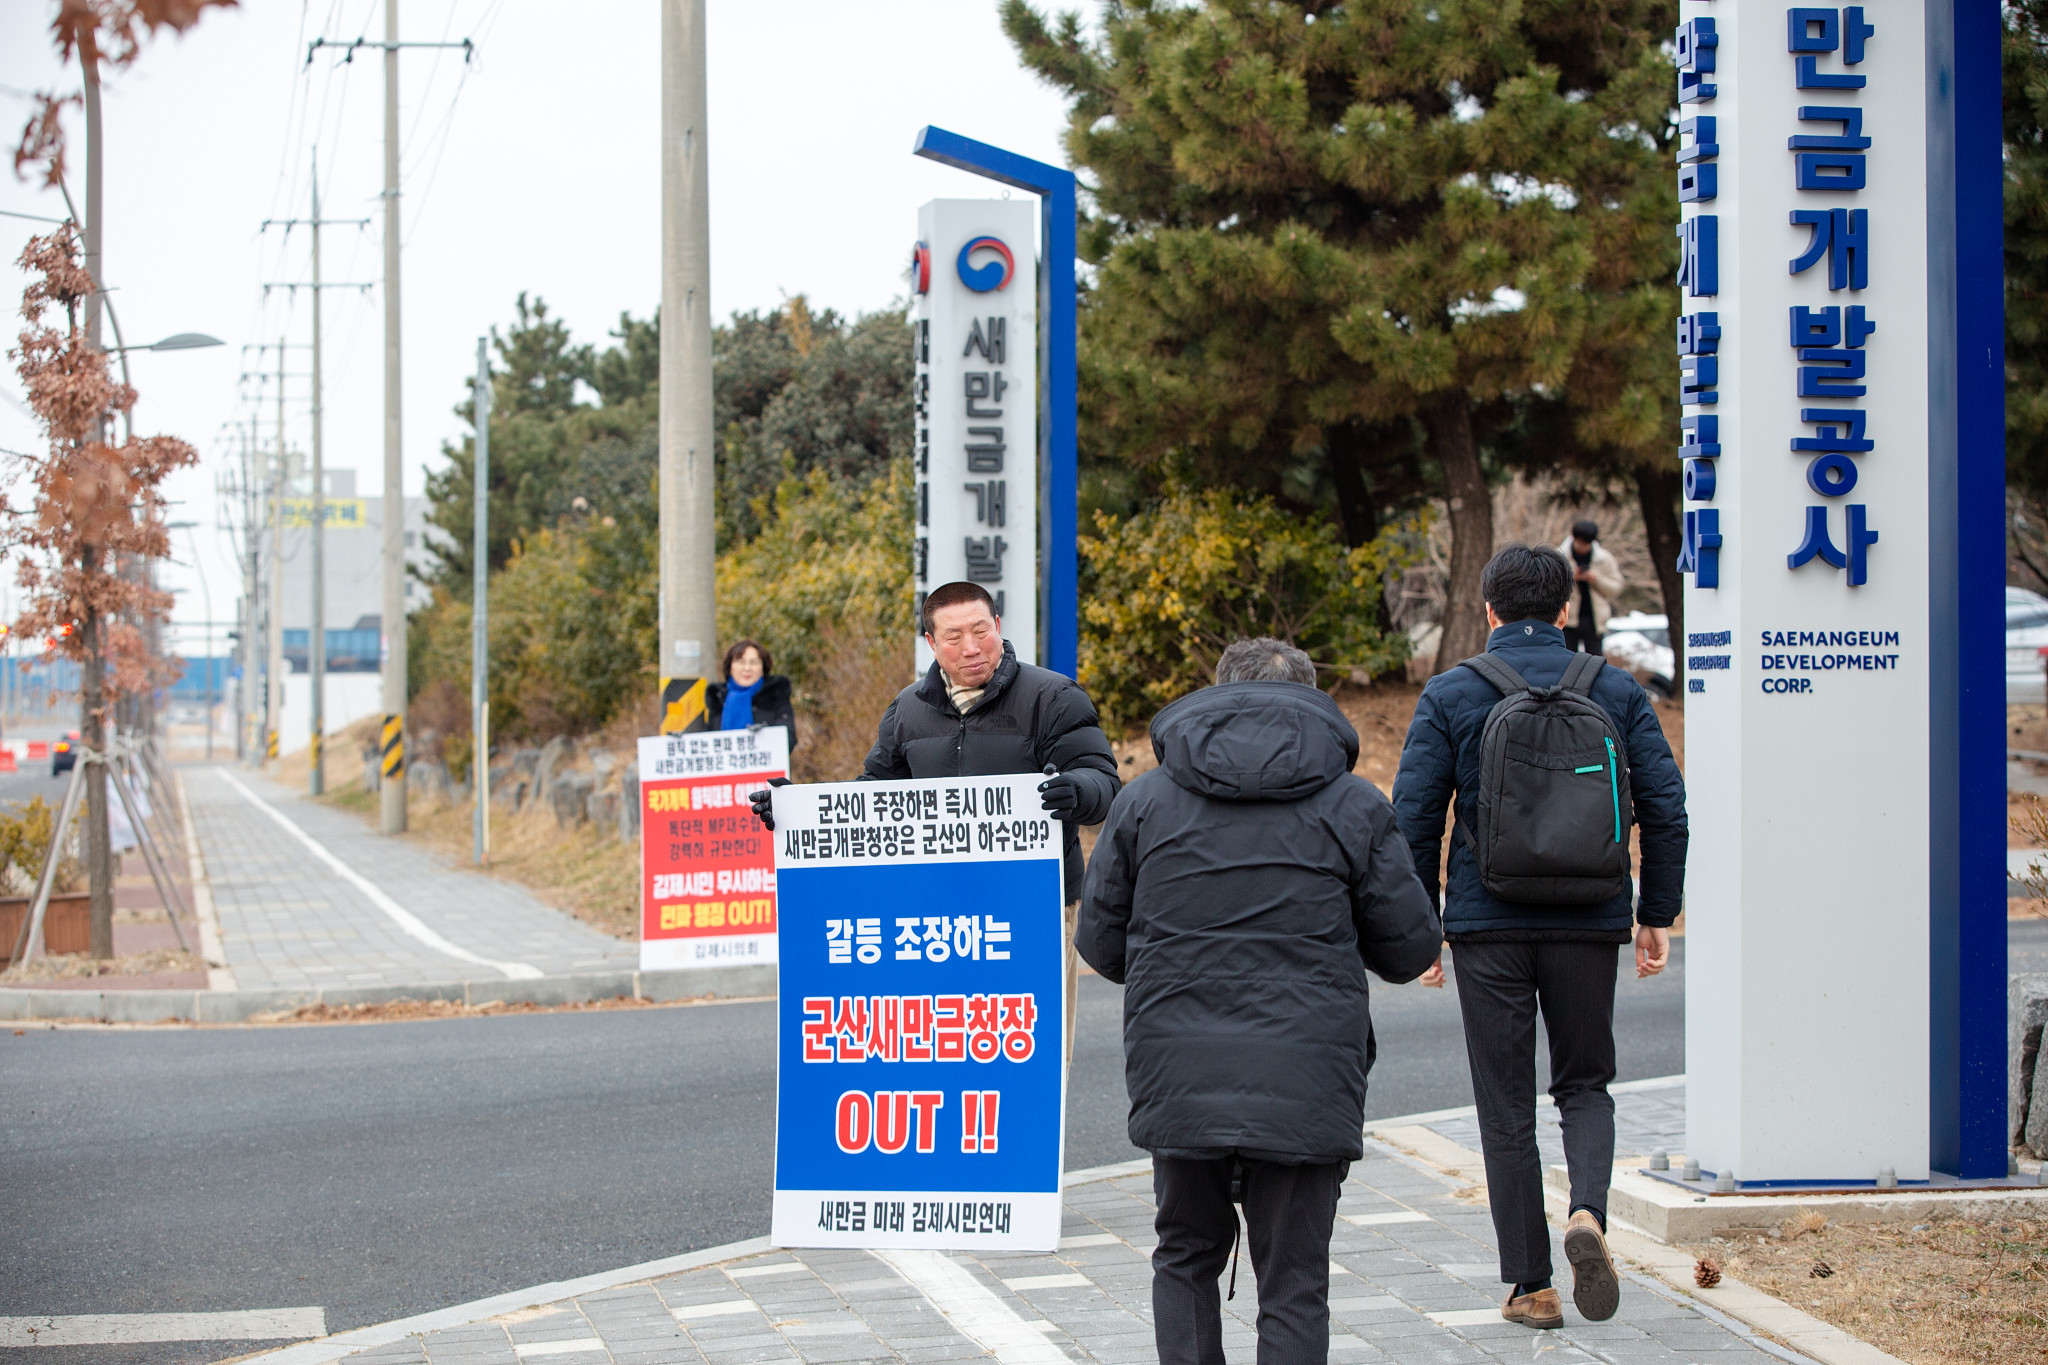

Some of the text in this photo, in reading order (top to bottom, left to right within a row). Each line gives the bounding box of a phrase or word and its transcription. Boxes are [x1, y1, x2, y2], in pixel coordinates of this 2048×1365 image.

[962, 315, 1008, 619] 새만금개발
[1760, 630, 1900, 647] SAEMANGEUM
[1760, 654, 1900, 671] DEVELOPMENT
[1760, 677, 1814, 694] CORP.
[655, 751, 772, 775] 새만금개발청은 각성하라!
[818, 786, 1012, 824] 군산이 주장하면 즉시 OK!
[668, 819, 704, 838] 독단적
[784, 819, 1050, 860] 새만금개발청장은 군산의 하수인??
[669, 837, 761, 862] 강력히 규탄한다!
[653, 867, 776, 900] 김제시민 무시하는
[660, 899, 772, 931] 편파 행정 OUT!
[826, 915, 1012, 964] 갈등 조장하는
[802, 993, 1038, 1064] 군산새만금청장
[835, 1090, 1001, 1154] OUT !!
[818, 1201, 1012, 1234] 새만금 미래 김제시민연대
